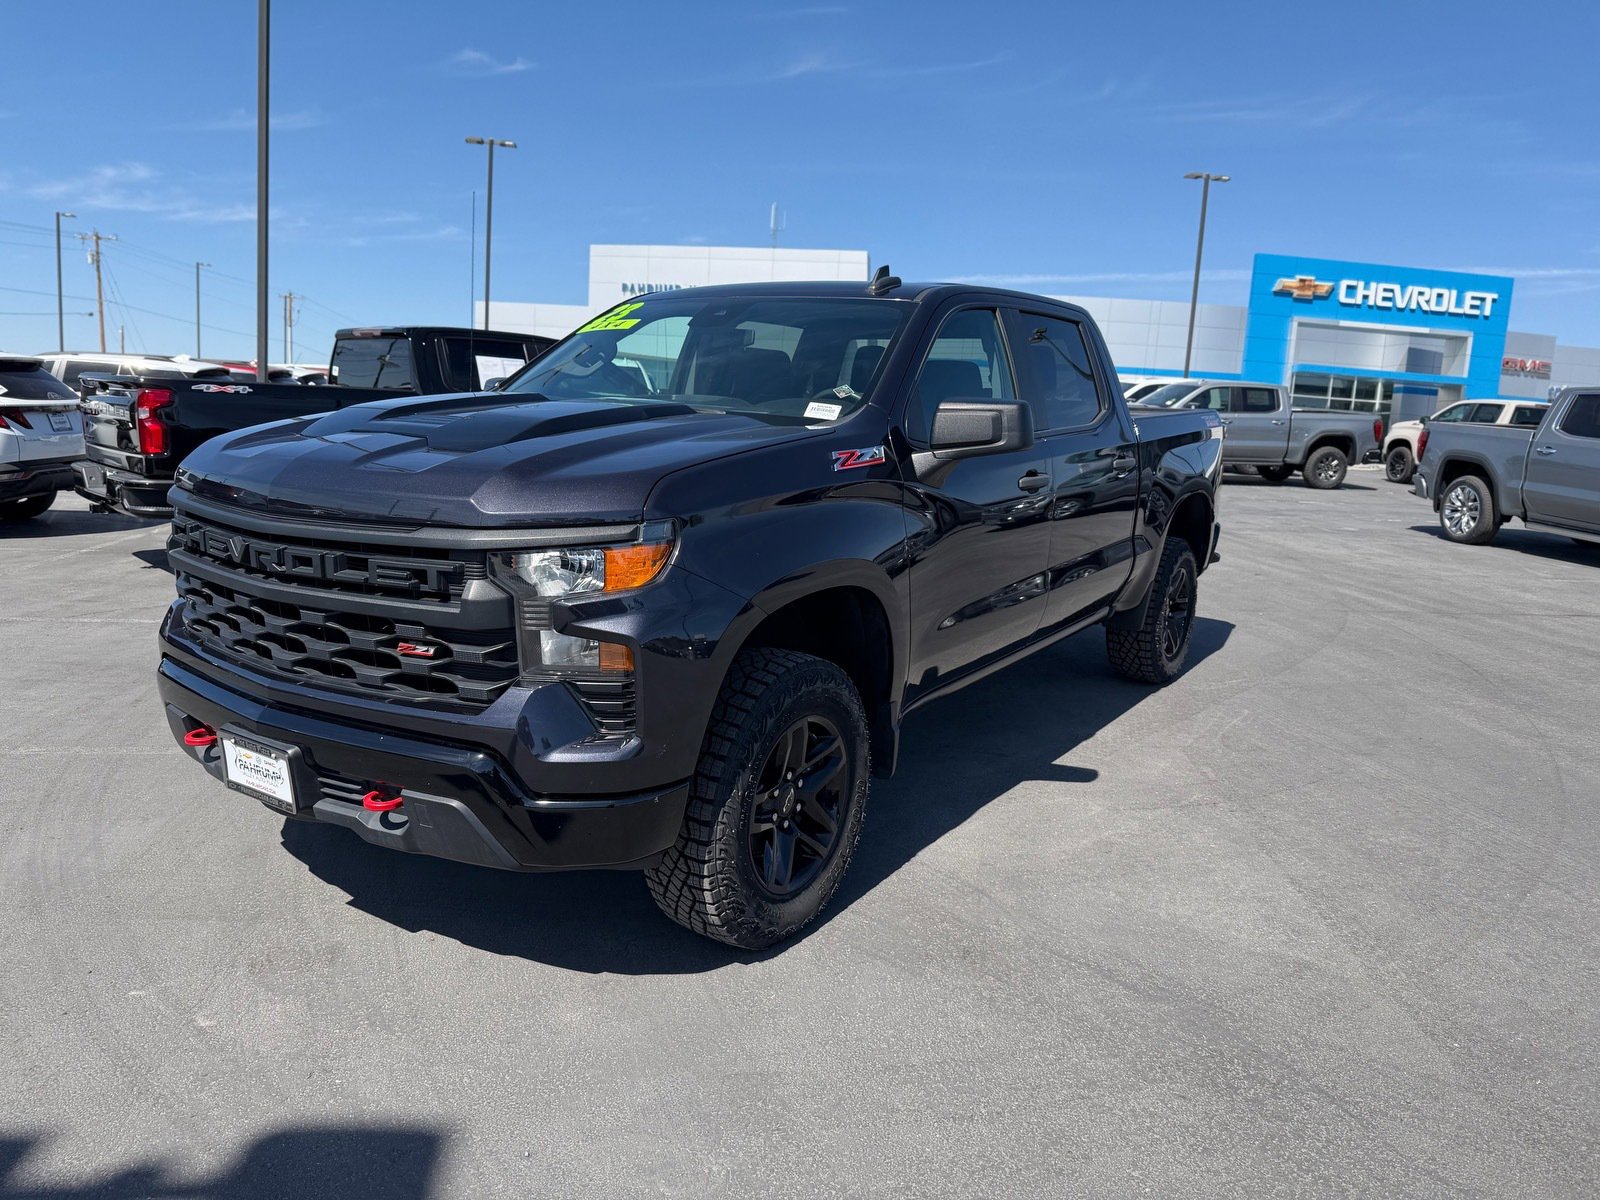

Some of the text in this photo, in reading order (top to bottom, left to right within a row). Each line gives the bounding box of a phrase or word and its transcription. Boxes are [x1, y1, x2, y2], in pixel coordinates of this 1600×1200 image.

[1338, 279, 1499, 317] CHEVROLET
[1502, 357, 1552, 374] GMC
[832, 445, 885, 471] Z71
